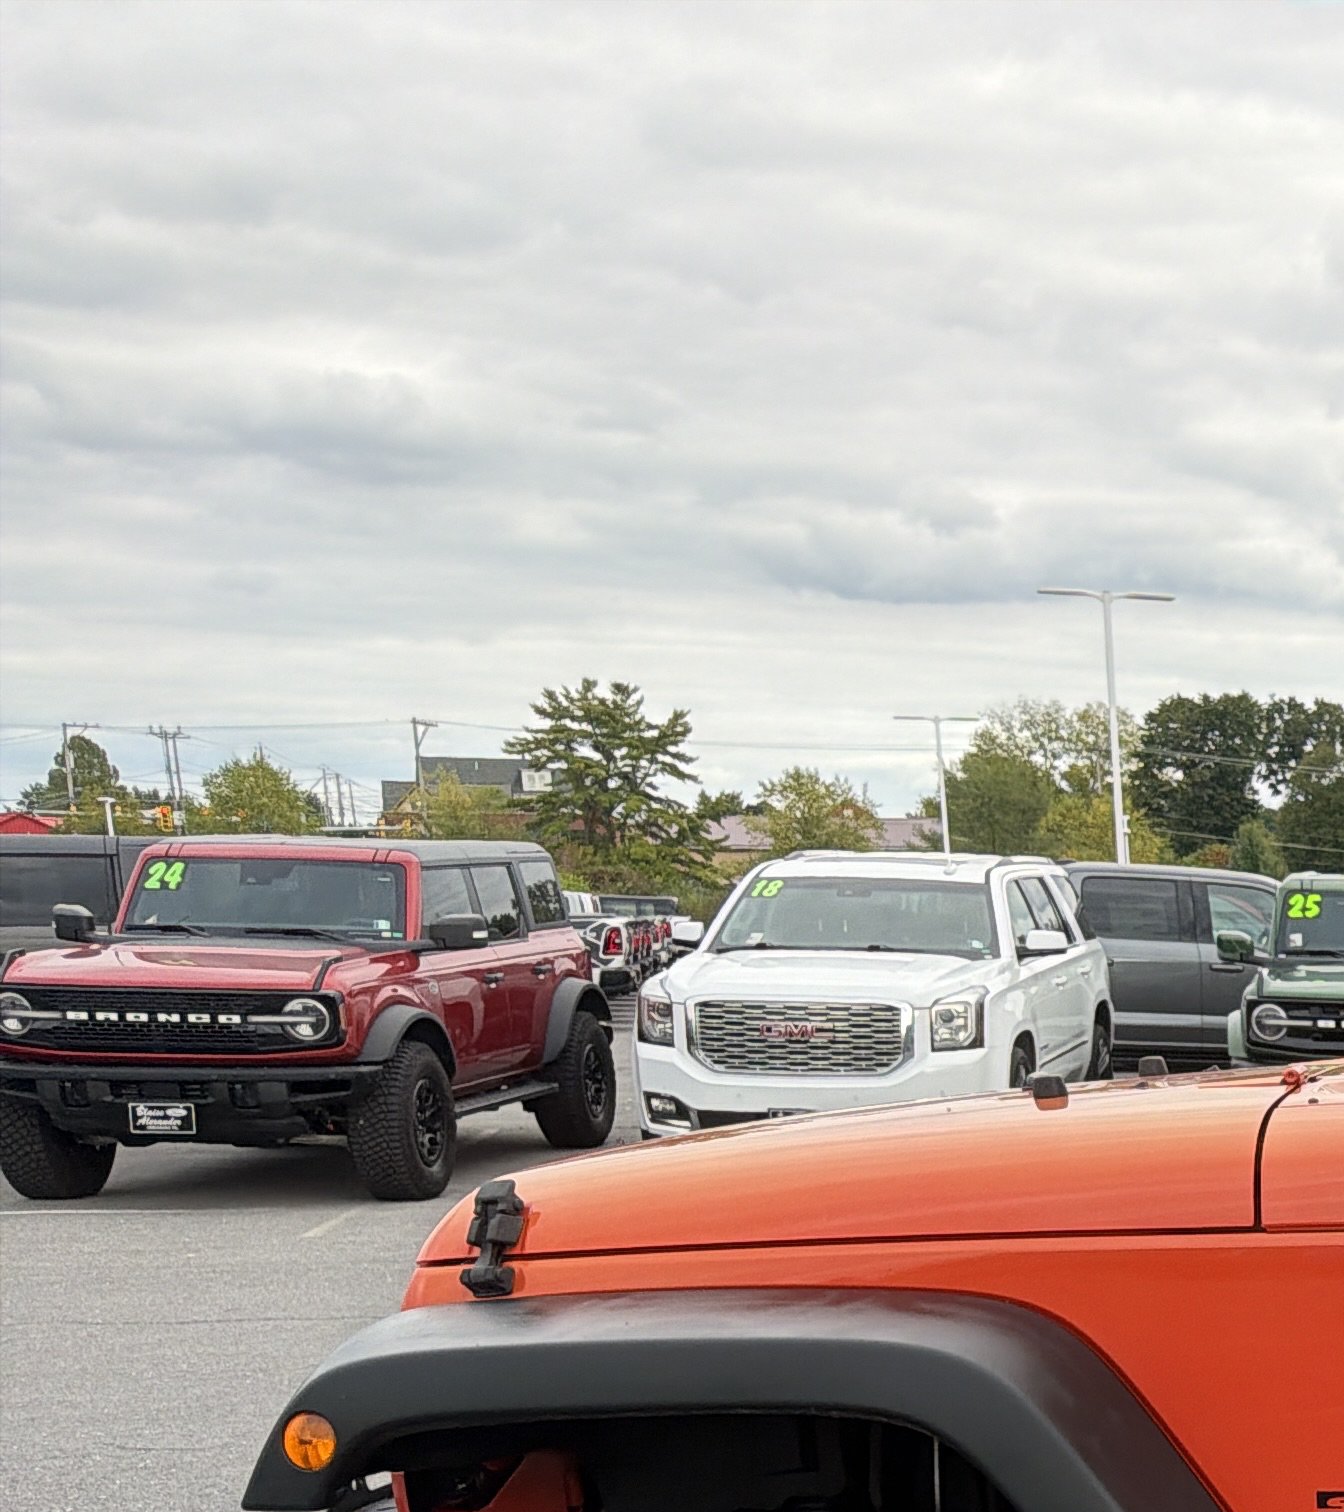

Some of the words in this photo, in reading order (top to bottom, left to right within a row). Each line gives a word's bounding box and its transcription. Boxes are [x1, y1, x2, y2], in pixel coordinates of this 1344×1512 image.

[144, 861, 186, 891] 24
[751, 880, 784, 897] 18
[1287, 893, 1322, 918] 25
[66, 1011, 241, 1024] BRONCO
[760, 1021, 834, 1039] GMC
